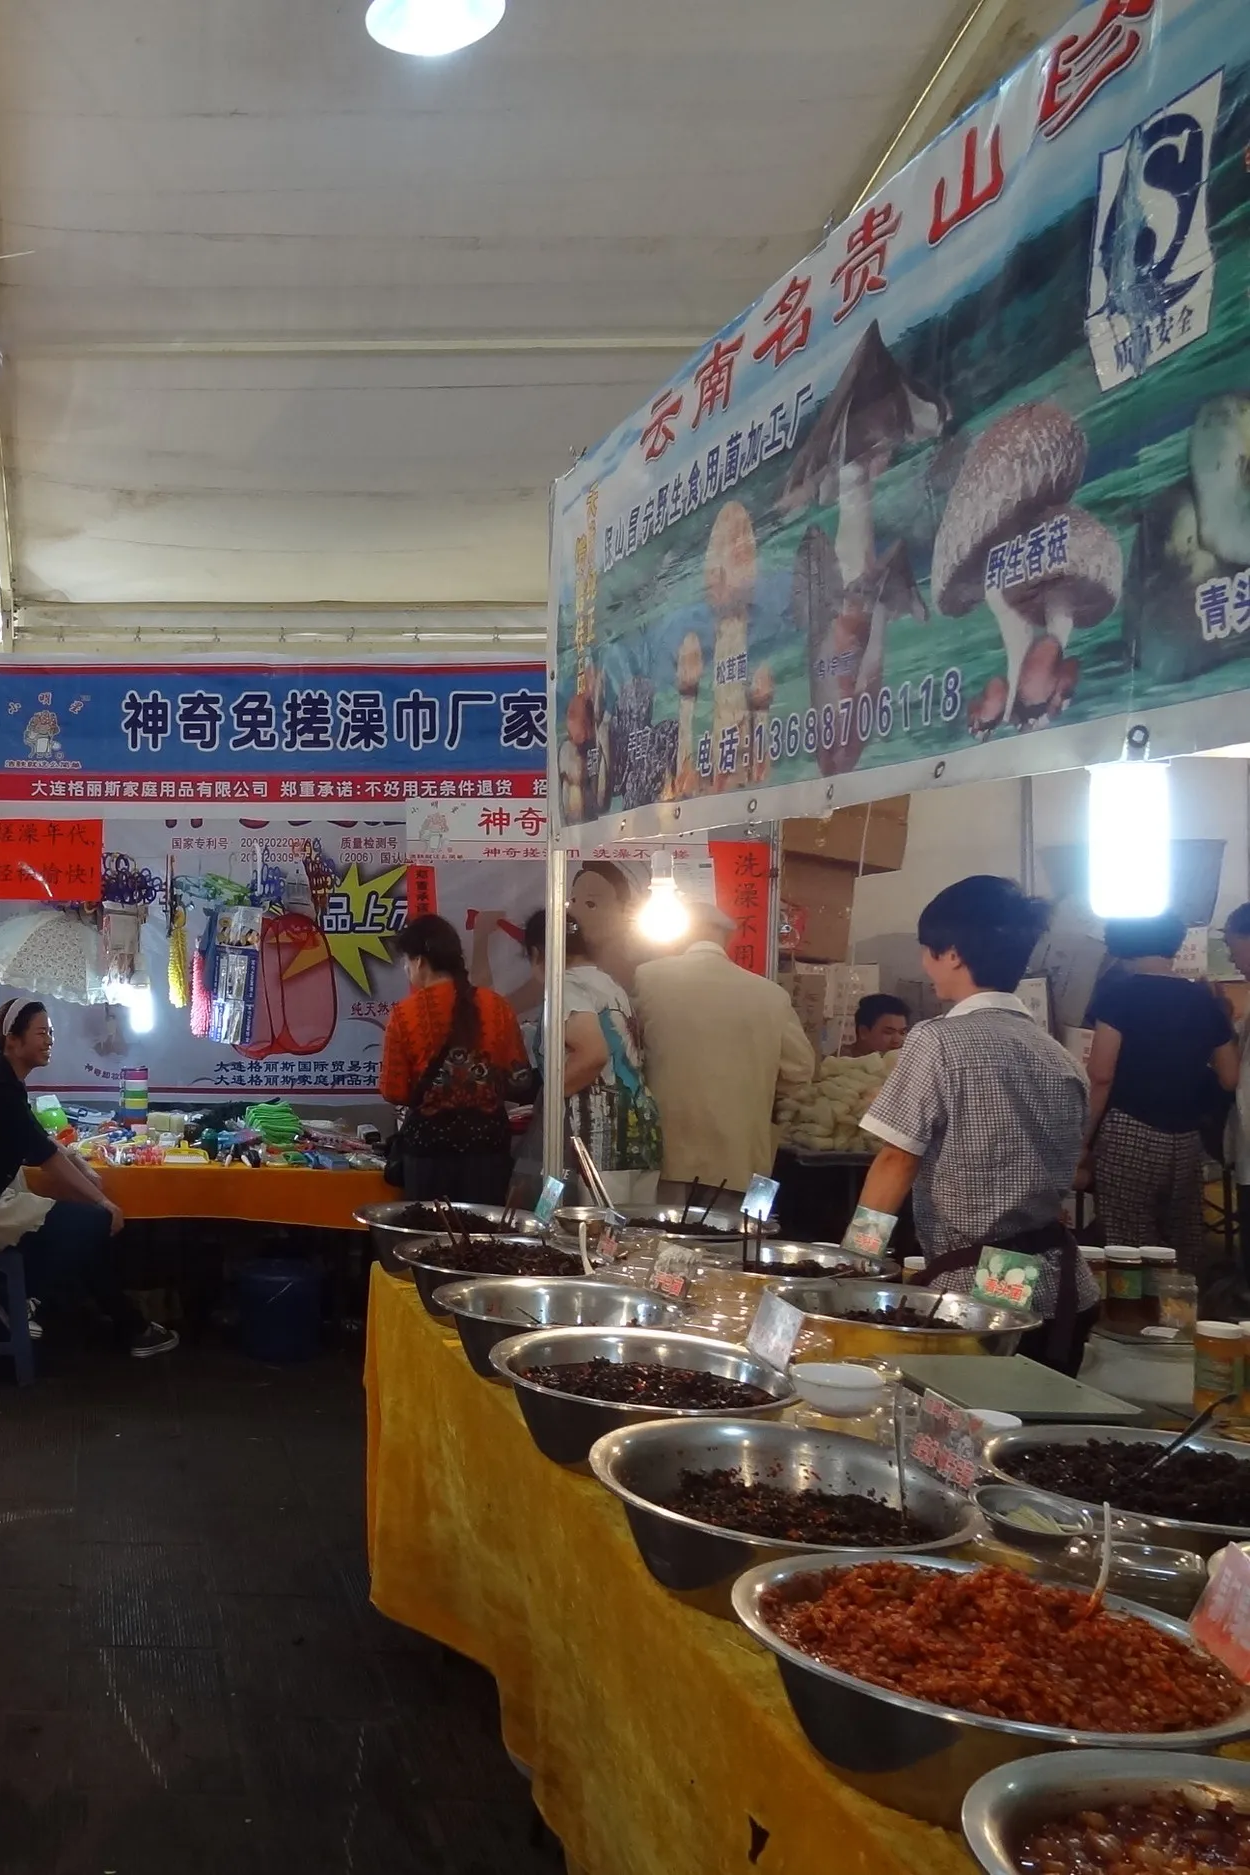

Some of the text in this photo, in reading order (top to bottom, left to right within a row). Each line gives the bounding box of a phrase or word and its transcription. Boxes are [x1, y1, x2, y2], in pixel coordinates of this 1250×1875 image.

[638, 0, 1154, 464] 云南名贵山珍
[984, 514, 1070, 591] 野生香菇
[121, 688, 547, 752] 神奇免搓澡巾厂家
[30, 780, 269, 799] 大连格丽斯家庭用品有限公司
[214, 1060, 383, 1074] 大连格丽斯国际贸易有
